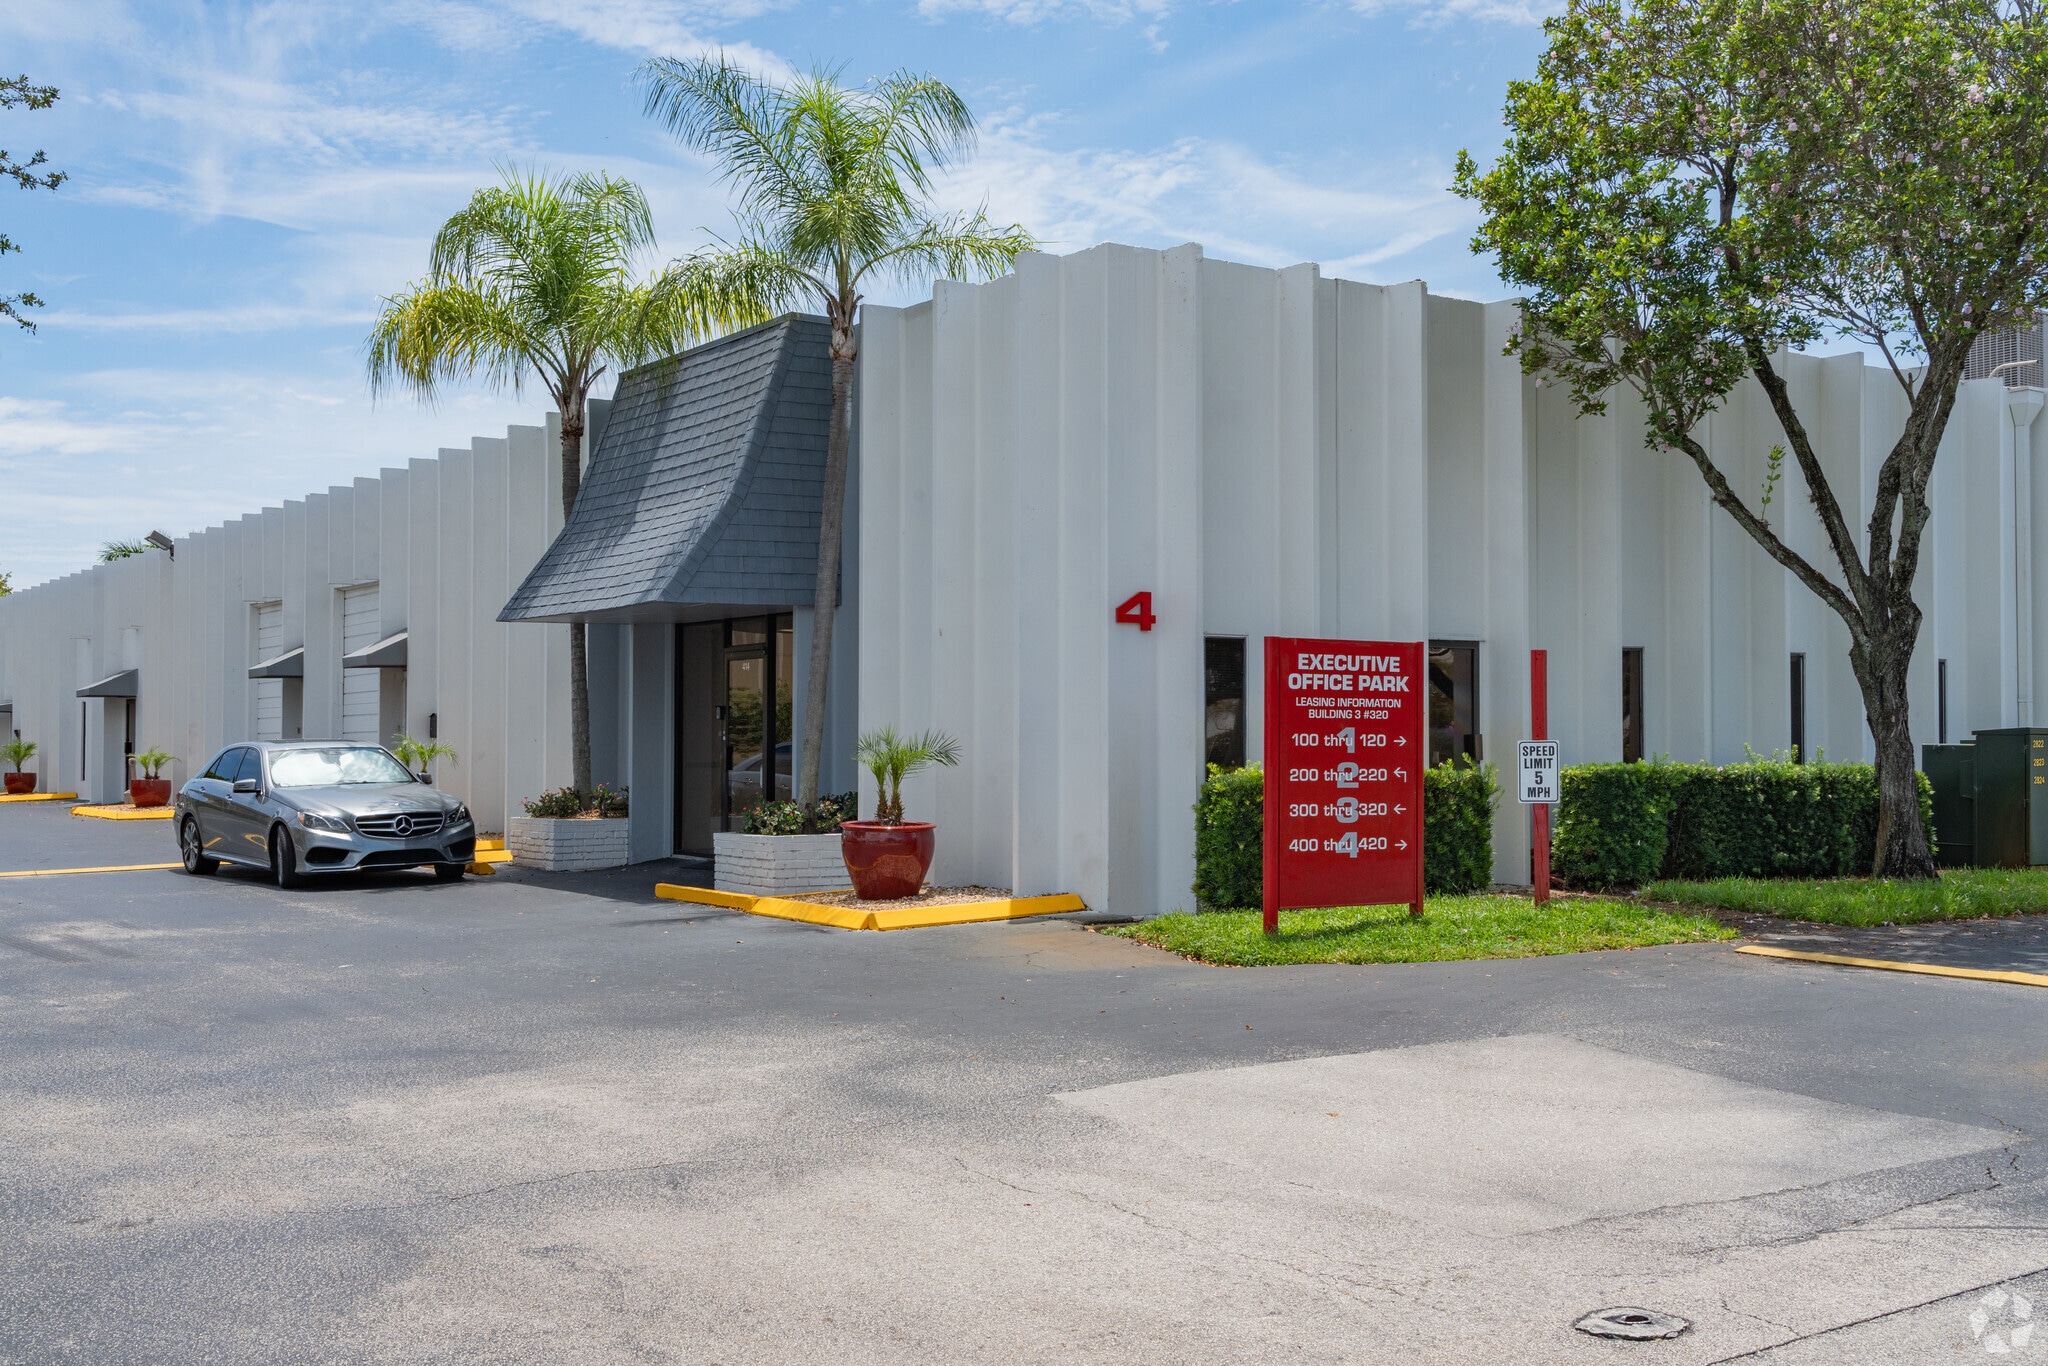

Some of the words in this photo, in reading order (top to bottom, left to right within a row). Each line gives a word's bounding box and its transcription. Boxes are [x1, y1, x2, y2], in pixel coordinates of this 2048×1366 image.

[1115, 591, 1156, 631] 4
[1298, 653, 1400, 673] EXECUTIVE
[1288, 673, 1353, 691] OFFICE
[1358, 675, 1409, 692] PARK
[1295, 697, 1335, 707] LEASING
[1337, 698, 1401, 708] INFORMATION
[1308, 709, 1352, 719] BUILDING
[1355, 710, 1361, 719] 3
[1363, 710, 1389, 719] #320
[1291, 733, 1319, 746] 100
[1323, 733, 1353, 746] thru
[1359, 734, 1387, 747] 120
[1337, 727, 1355, 753] 1
[1522, 746, 1555, 757] SPEED
[1524, 758, 1553, 769] LIMIT
[1289, 768, 1319, 781] 200
[1323, 768, 1353, 781] thru
[1358, 768, 1388, 781] 220
[1337, 762, 1359, 788] 2
[1534, 771, 1543, 785] 5
[1527, 787, 1550, 798] MPH
[1289, 803, 1319, 817] 300
[1323, 803, 1353, 816] thru
[1358, 803, 1388, 816] 320
[1336, 796, 1359, 823] 3
[1288, 838, 1319, 852] 400
[1323, 838, 1353, 851] thru
[1358, 837, 1388, 850] 420
[1336, 831, 1359, 858] 4
